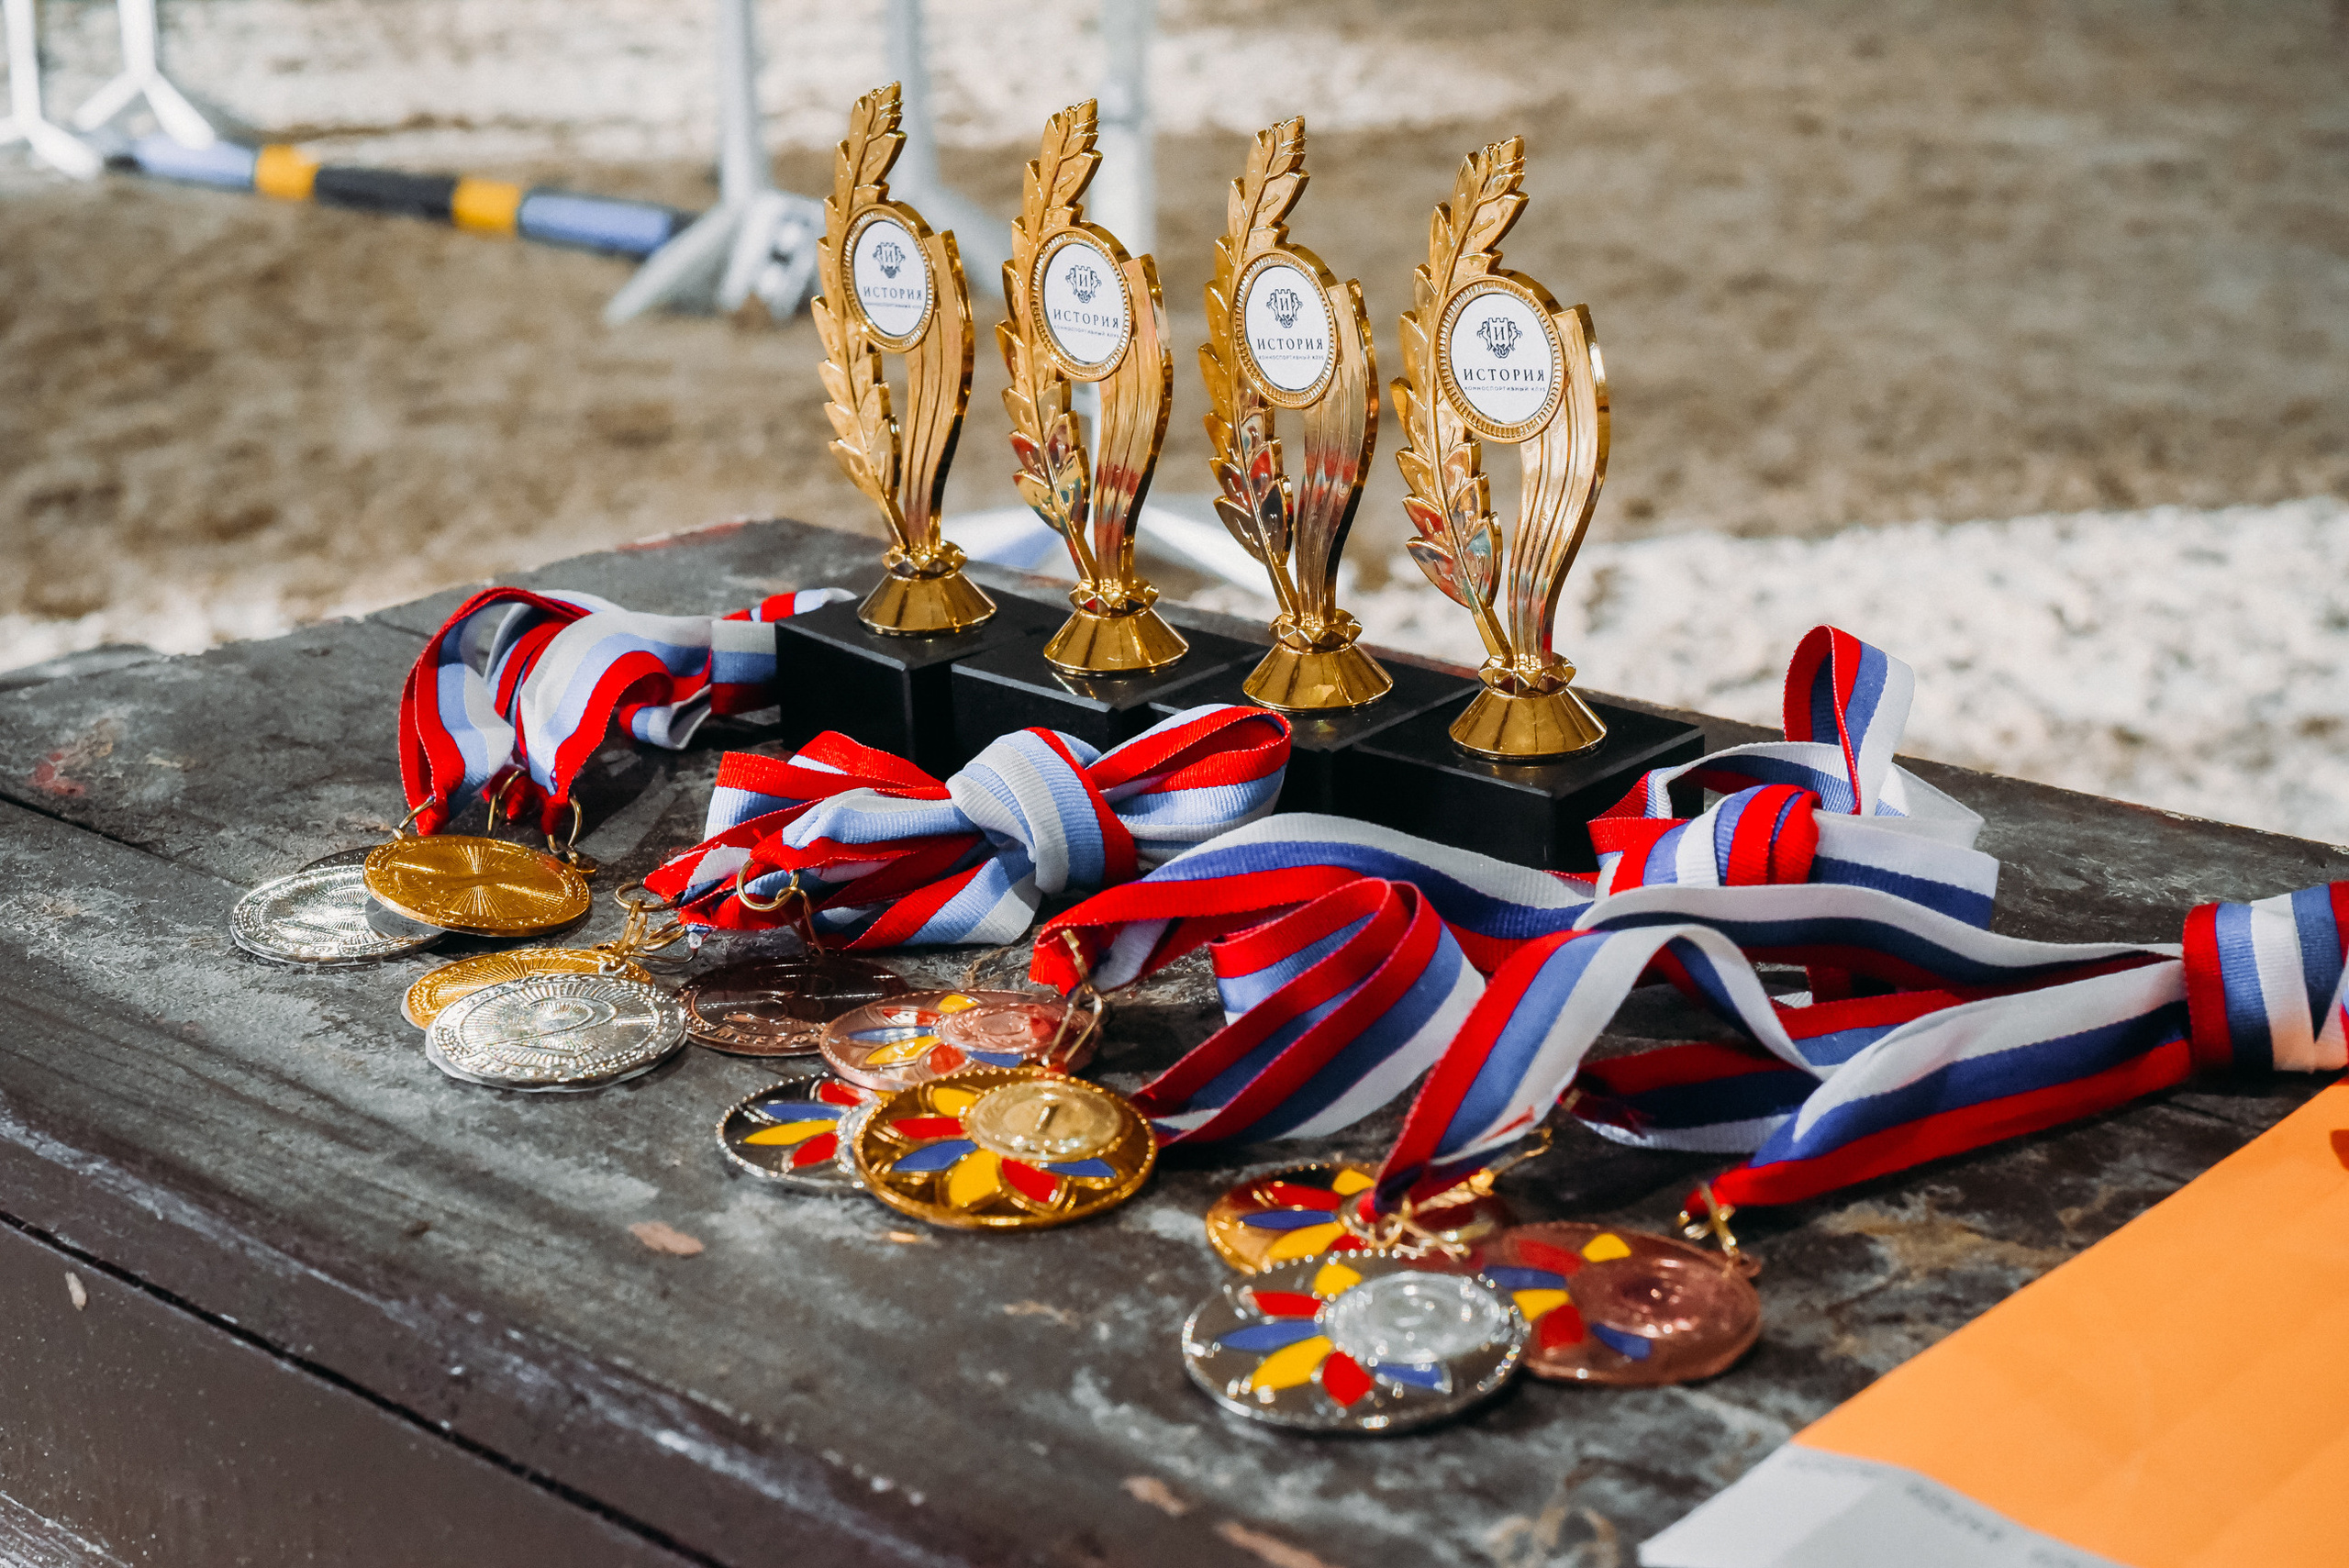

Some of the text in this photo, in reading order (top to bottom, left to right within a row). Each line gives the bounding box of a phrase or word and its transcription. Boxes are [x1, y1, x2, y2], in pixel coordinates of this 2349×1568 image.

[1079, 274, 1088, 287] И
[863, 286, 922, 301] ИСТОРИЯ
[1280, 298, 1289, 311] И
[1053, 308, 1119, 328] ИСТОРИЯ
[1495, 327, 1505, 340] И
[1257, 338, 1323, 350] ИСТОРИЯ
[1464, 368, 1544, 382] ИСТОРИЯ
[486, 995, 618, 1058] 2
